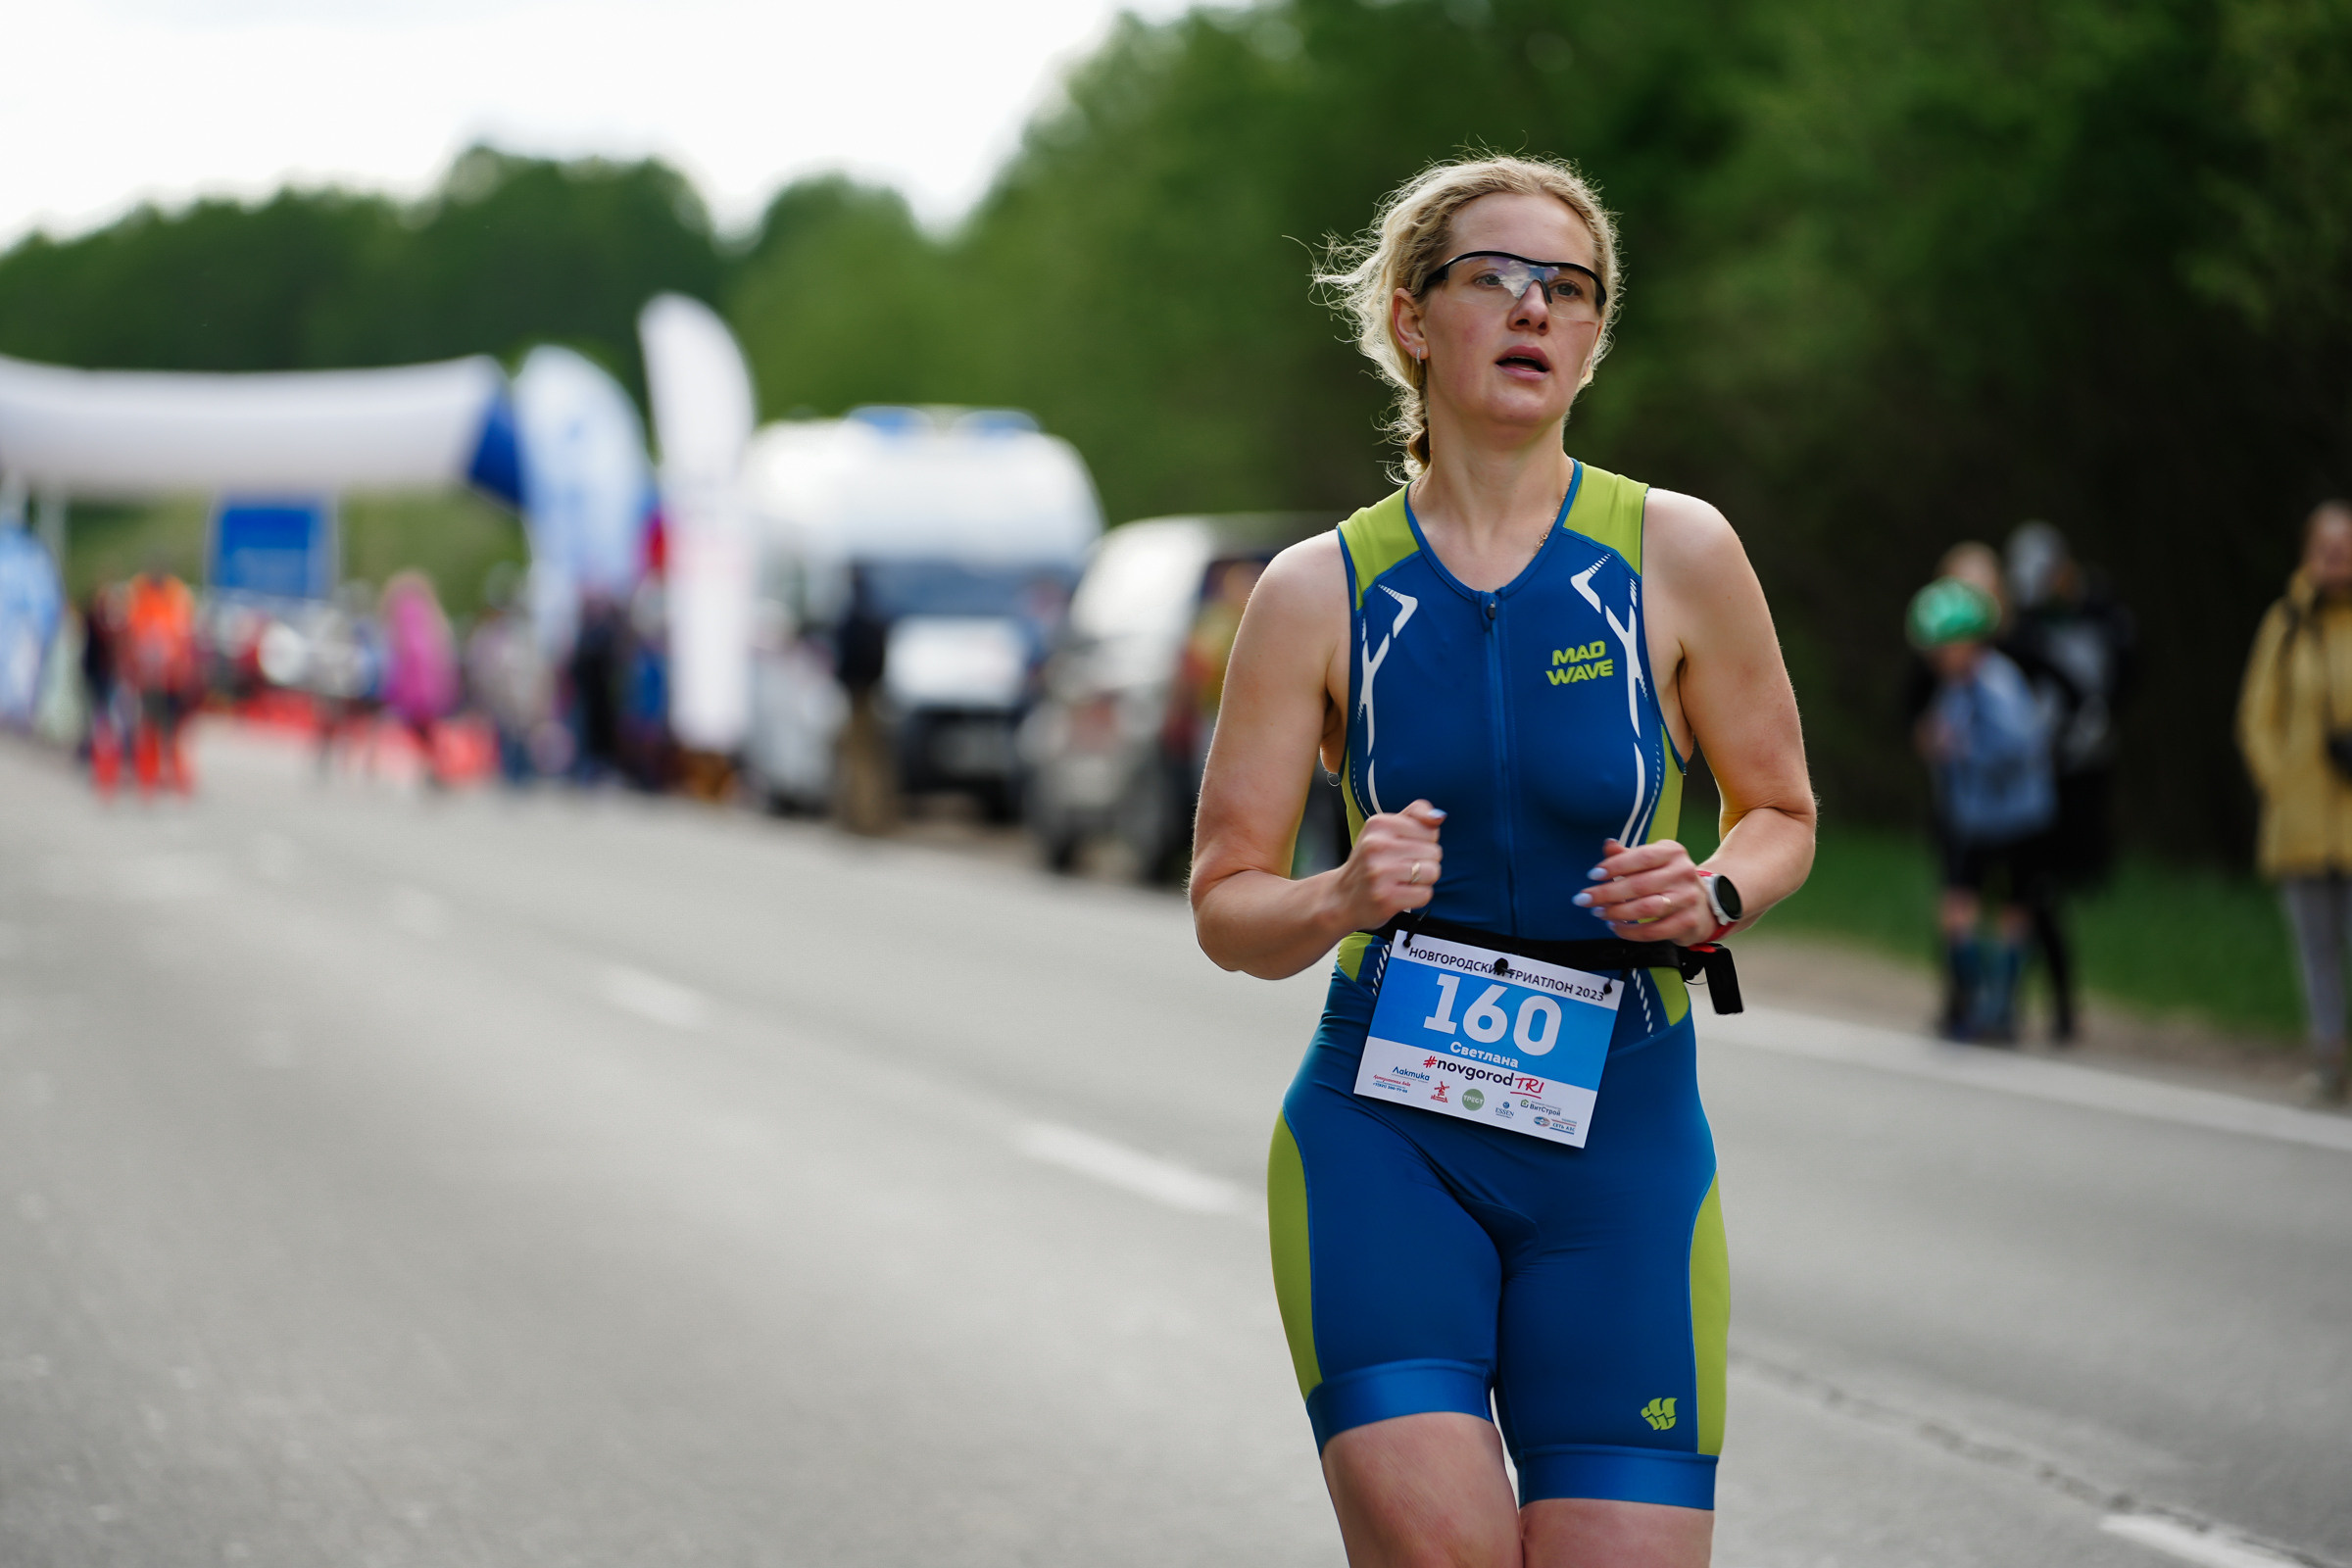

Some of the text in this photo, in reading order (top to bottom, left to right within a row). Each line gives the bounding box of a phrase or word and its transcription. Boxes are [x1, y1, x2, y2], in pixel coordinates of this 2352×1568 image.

[1552, 640, 1606, 666] MAD
[1545, 659, 1614, 686] WAVE
[1575, 986, 1605, 1002] 2023
[1423, 973, 1562, 1056] 160
[1449, 1041, 1519, 1069] Светлана
[1392, 1066, 1430, 1081] Лактика
[1494, 1107, 1515, 1117] ESSEN
[1529, 1103, 1561, 1116] ВитСтрой
